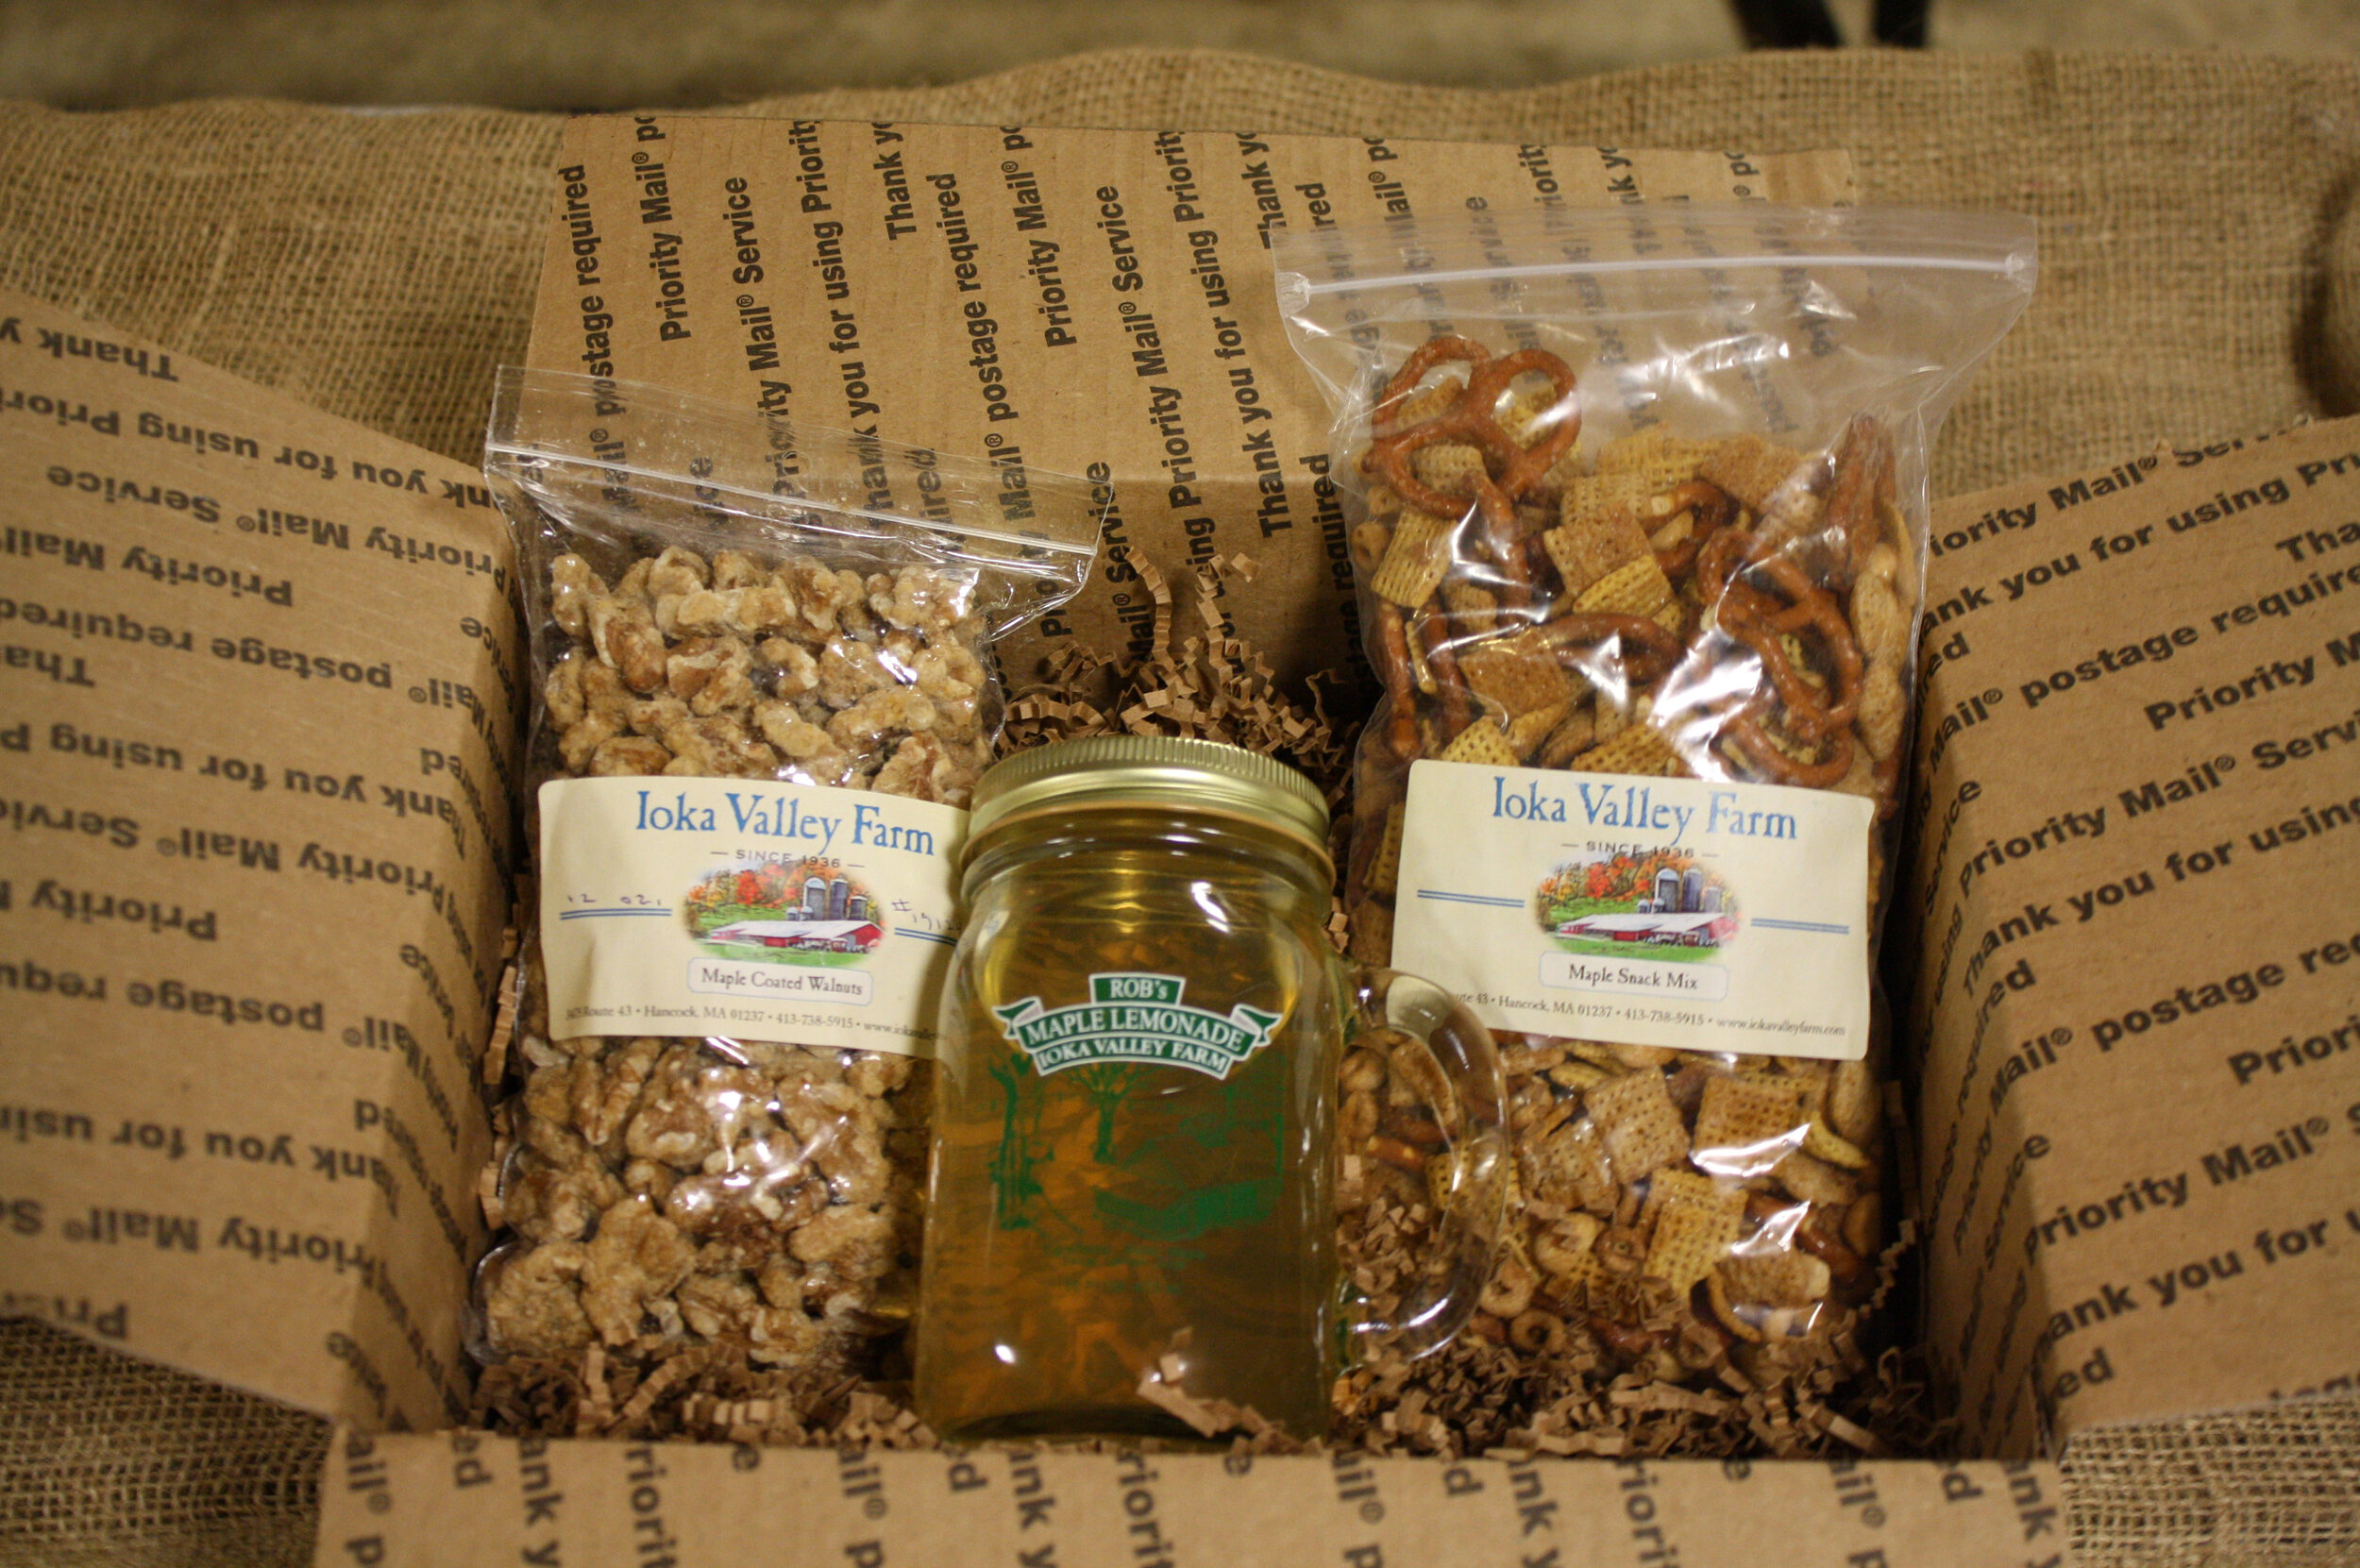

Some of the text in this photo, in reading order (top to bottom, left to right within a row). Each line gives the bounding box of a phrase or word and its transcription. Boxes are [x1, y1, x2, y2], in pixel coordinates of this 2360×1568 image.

[632, 151, 673, 225] Mail®
[873, 150, 918, 241] Thank
[1001, 160, 1047, 232] Mail®
[1240, 160, 1287, 250] Thank
[558, 164, 601, 286] required
[723, 177, 764, 284] Service
[925, 173, 982, 293] required
[649, 232, 692, 342] Priority
[813, 221, 850, 300] using
[1188, 229, 1231, 309] using
[1027, 239, 1078, 348] Priority
[38, 328, 178, 382] Thank
[581, 295, 626, 416] postage
[735, 294, 780, 371] Mail®
[829, 309, 860, 354] for
[964, 301, 1020, 422] postage
[1096, 185, 1203, 509] Priority Mail® Service
[1214, 316, 1246, 360] for
[841, 361, 881, 419] you
[1228, 367, 1273, 425] you
[138, 412, 259, 459] using
[274, 447, 337, 480] for
[47, 465, 221, 524] Service
[352, 462, 429, 495] you
[1241, 429, 1292, 538] Thank
[2048, 454, 2158, 512] Mail®
[236, 507, 349, 549] Mail®
[1087, 462, 1138, 583] Service
[1998, 553, 2082, 601] you
[2089, 524, 2153, 563] for
[2166, 478, 2290, 532] using
[122, 546, 294, 608] Priority
[211, 637, 393, 689] postage
[2020, 627, 2200, 709] postage
[2144, 655, 2315, 731] Priority
[51, 722, 183, 771] using
[198, 755, 268, 791] for
[284, 768, 367, 803] you
[1492, 776, 1796, 846] Ioka Valley Farm
[2118, 754, 2236, 818] Mail®
[635, 790, 935, 856] Ioka Valley Farm
[1586, 840, 1642, 856] SINCE
[735, 849, 840, 868] SINCE 1936
[2067, 870, 2155, 923] you
[2165, 840, 2233, 883] for
[30, 879, 216, 942] Priority
[126, 980, 323, 1031] postage
[701, 968, 863, 996] Maple Coated Walnuts
[1109, 978, 1168, 999] ROB's
[1568, 964, 1698, 990] Maple Snack Mix
[703, 1007, 727, 1020] MA
[731, 1009, 764, 1021] 01237
[776, 1013, 853, 1029] 413-738-5915
[1025, 1008, 1246, 1052] MAPLE LEMONADE
[1553, 1002, 1575, 1015] MA
[1577, 1003, 1612, 1019] 01237
[1624, 1007, 1704, 1026] 413-738-5915
[2091, 963, 2285, 1054] postage
[1038, 1037, 1226, 1071] IOKA VALLEY FARM
[110, 1120, 187, 1160] for
[205, 1131, 295, 1167] you
[2148, 1249, 2244, 1309] you
[2254, 1220, 2328, 1264] for
